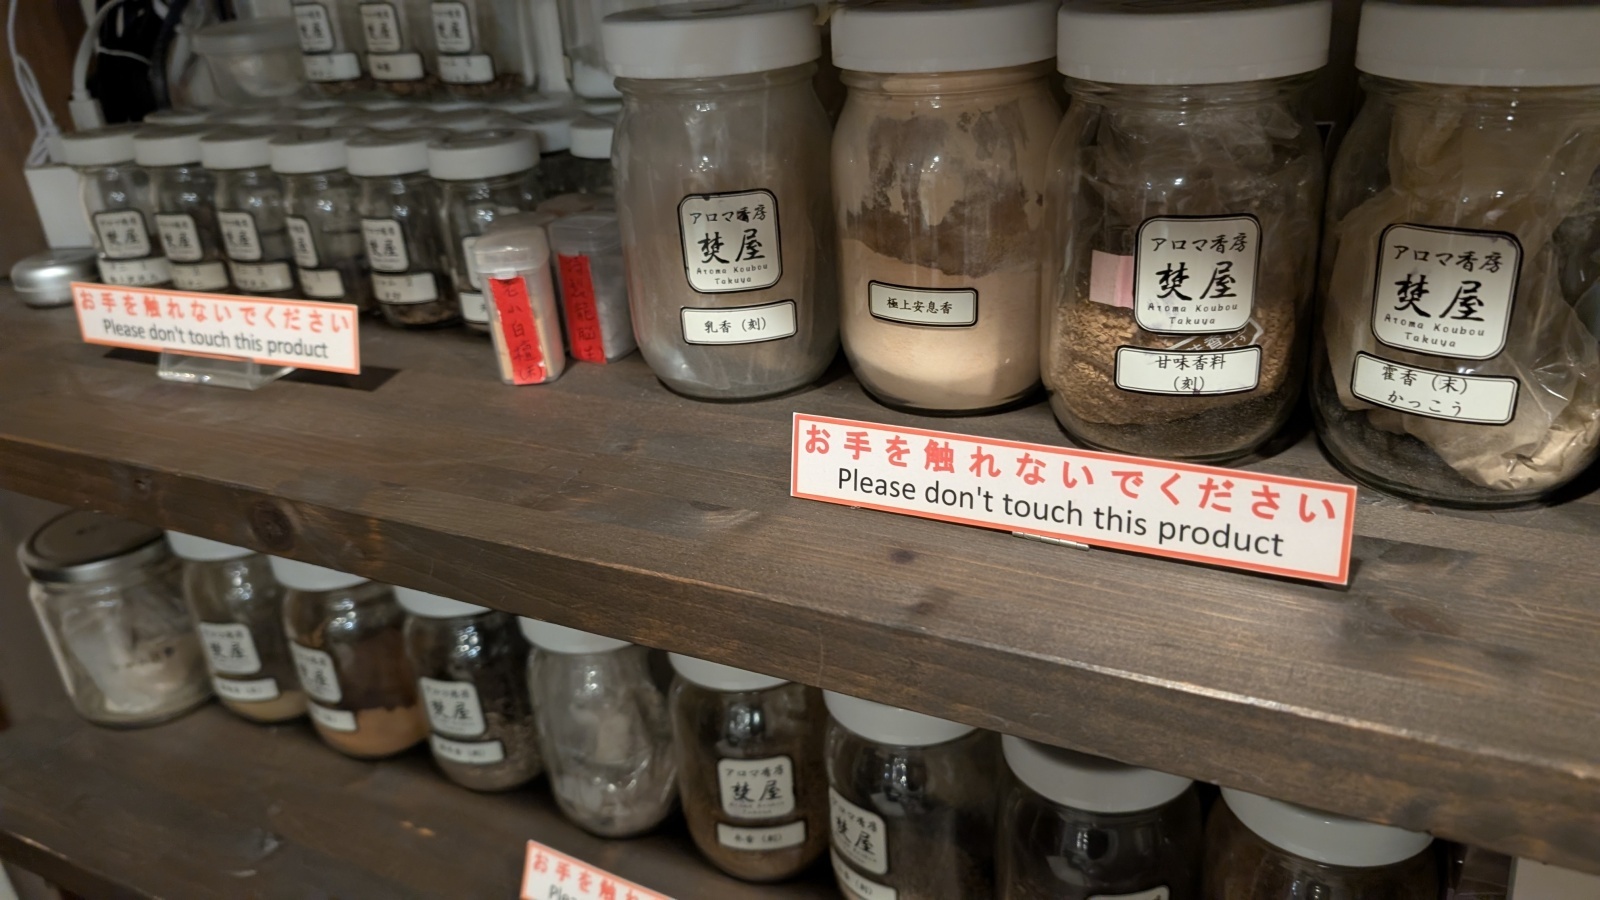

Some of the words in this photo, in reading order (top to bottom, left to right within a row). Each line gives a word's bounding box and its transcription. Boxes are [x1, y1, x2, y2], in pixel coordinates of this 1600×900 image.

[689, 204, 768, 225] アロマ香房
[697, 228, 766, 264] 焚屋
[1151, 232, 1248, 253] アロマ香房
[733, 263, 768, 274] Koubou
[1393, 245, 1503, 273] アロマ香房
[714, 276, 752, 286] Takuya
[1155, 261, 1238, 301] 焚屋
[886, 297, 953, 315] 極上安息香
[1147, 302, 1187, 313] Aroma
[1195, 303, 1238, 313] Koubou
[1394, 274, 1485, 322] 焚屋
[79, 290, 350, 333] お手を触れないでください
[1169, 316, 1216, 327] Takuya
[1384, 313, 1424, 330] Aroma
[1433, 323, 1485, 337] Koubou
[103, 318, 145, 340] Please
[150, 324, 186, 344] don't
[188, 329, 231, 349] touch
[235, 333, 263, 352] this
[267, 337, 329, 360] product
[1404, 331, 1456, 348] Takuya
[1155, 354, 1227, 371] 甘味香料
[1387, 390, 1463, 417] かっこう
[804, 424, 1337, 523] お手を触れないでください
[838, 467, 916, 500] Please
[925, 481, 994, 513] don't
[1002, 493, 1083, 526] touch
[1093, 505, 1147, 536] this
[1158, 520, 1285, 557] product
